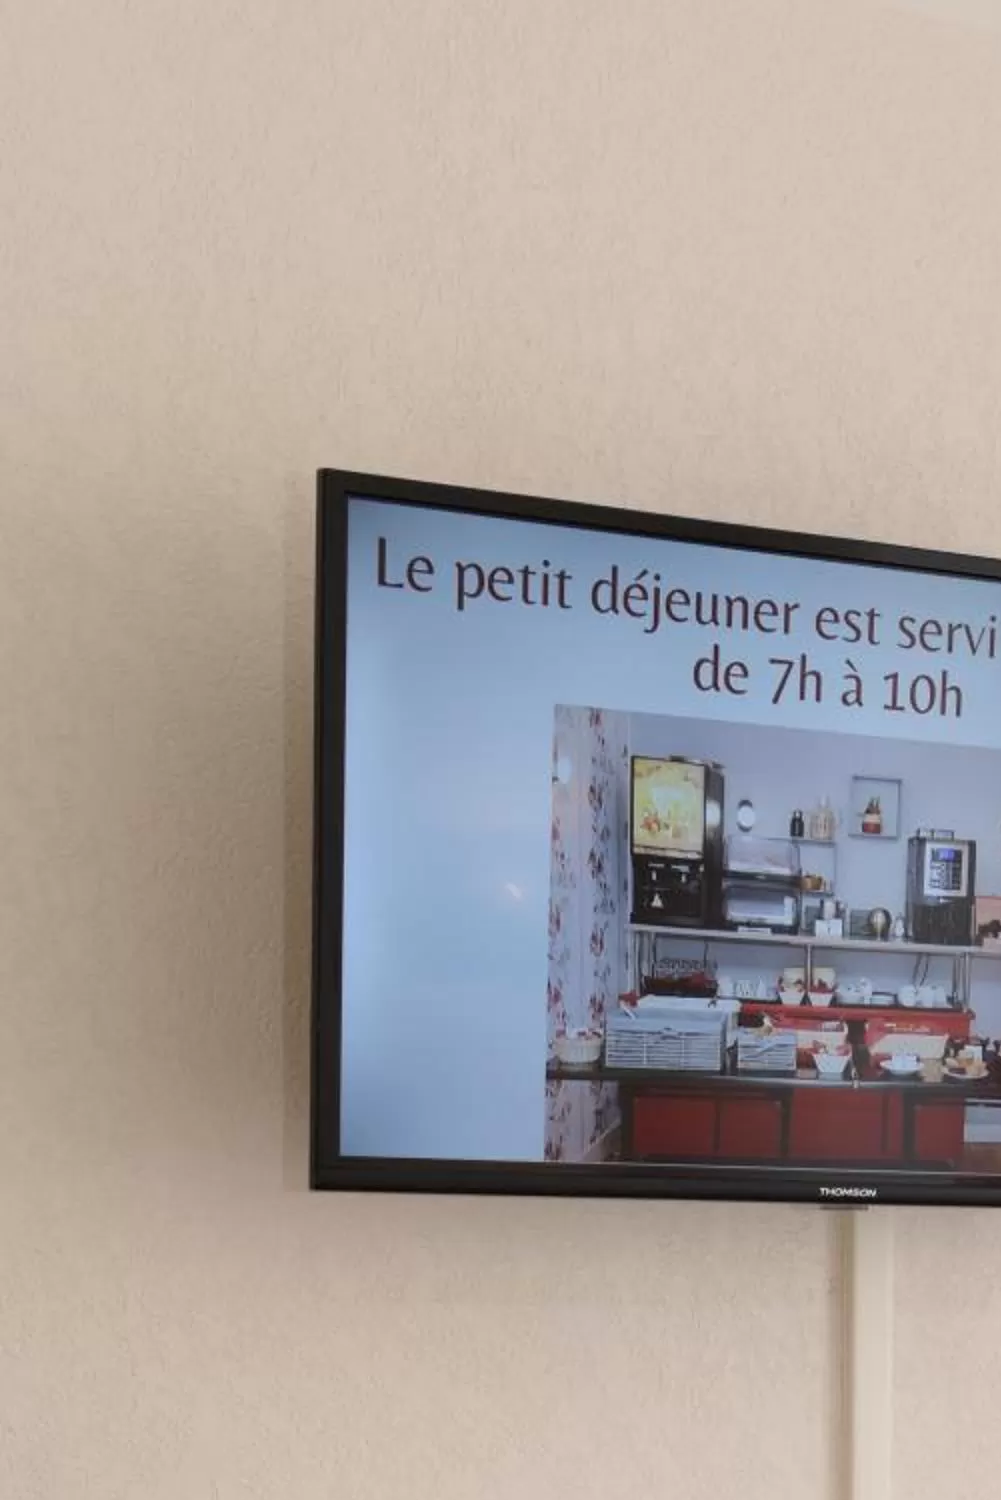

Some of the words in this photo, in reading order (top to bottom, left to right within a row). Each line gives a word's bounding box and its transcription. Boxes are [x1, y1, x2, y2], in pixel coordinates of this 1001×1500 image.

[376, 536, 435, 593] Le
[455, 558, 573, 611] petit
[591, 564, 800, 635] déjeuner
[815, 605, 881, 645] est
[897, 615, 997, 659] servi
[693, 643, 750, 695] de
[768, 652, 823, 704] 7h
[841, 659, 864, 708] à
[883, 669, 962, 718] 10h
[819, 1187, 878, 1198] THOMSON
